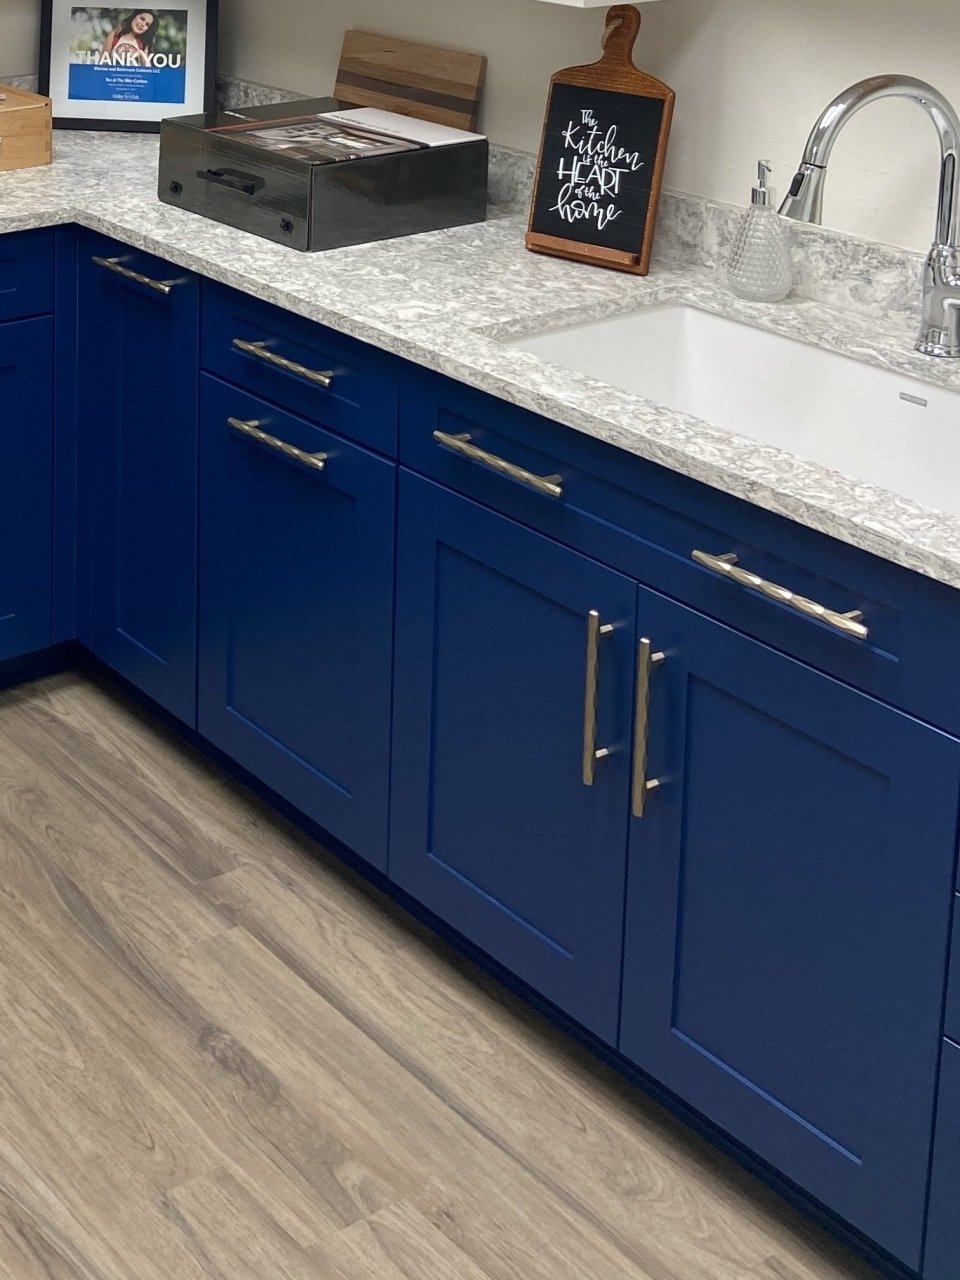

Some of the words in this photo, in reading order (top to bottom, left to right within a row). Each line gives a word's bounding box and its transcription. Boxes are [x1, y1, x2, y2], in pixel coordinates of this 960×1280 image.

[76, 50, 140, 66] THANK
[143, 52, 181, 69] YOU
[580, 109, 598, 126] The
[561, 120, 644, 170] Kitchen
[594, 154, 609, 168] the
[556, 156, 630, 198] HEART
[575, 185, 585, 198] of
[584, 186, 600, 200] the
[548, 182, 623, 230] home
